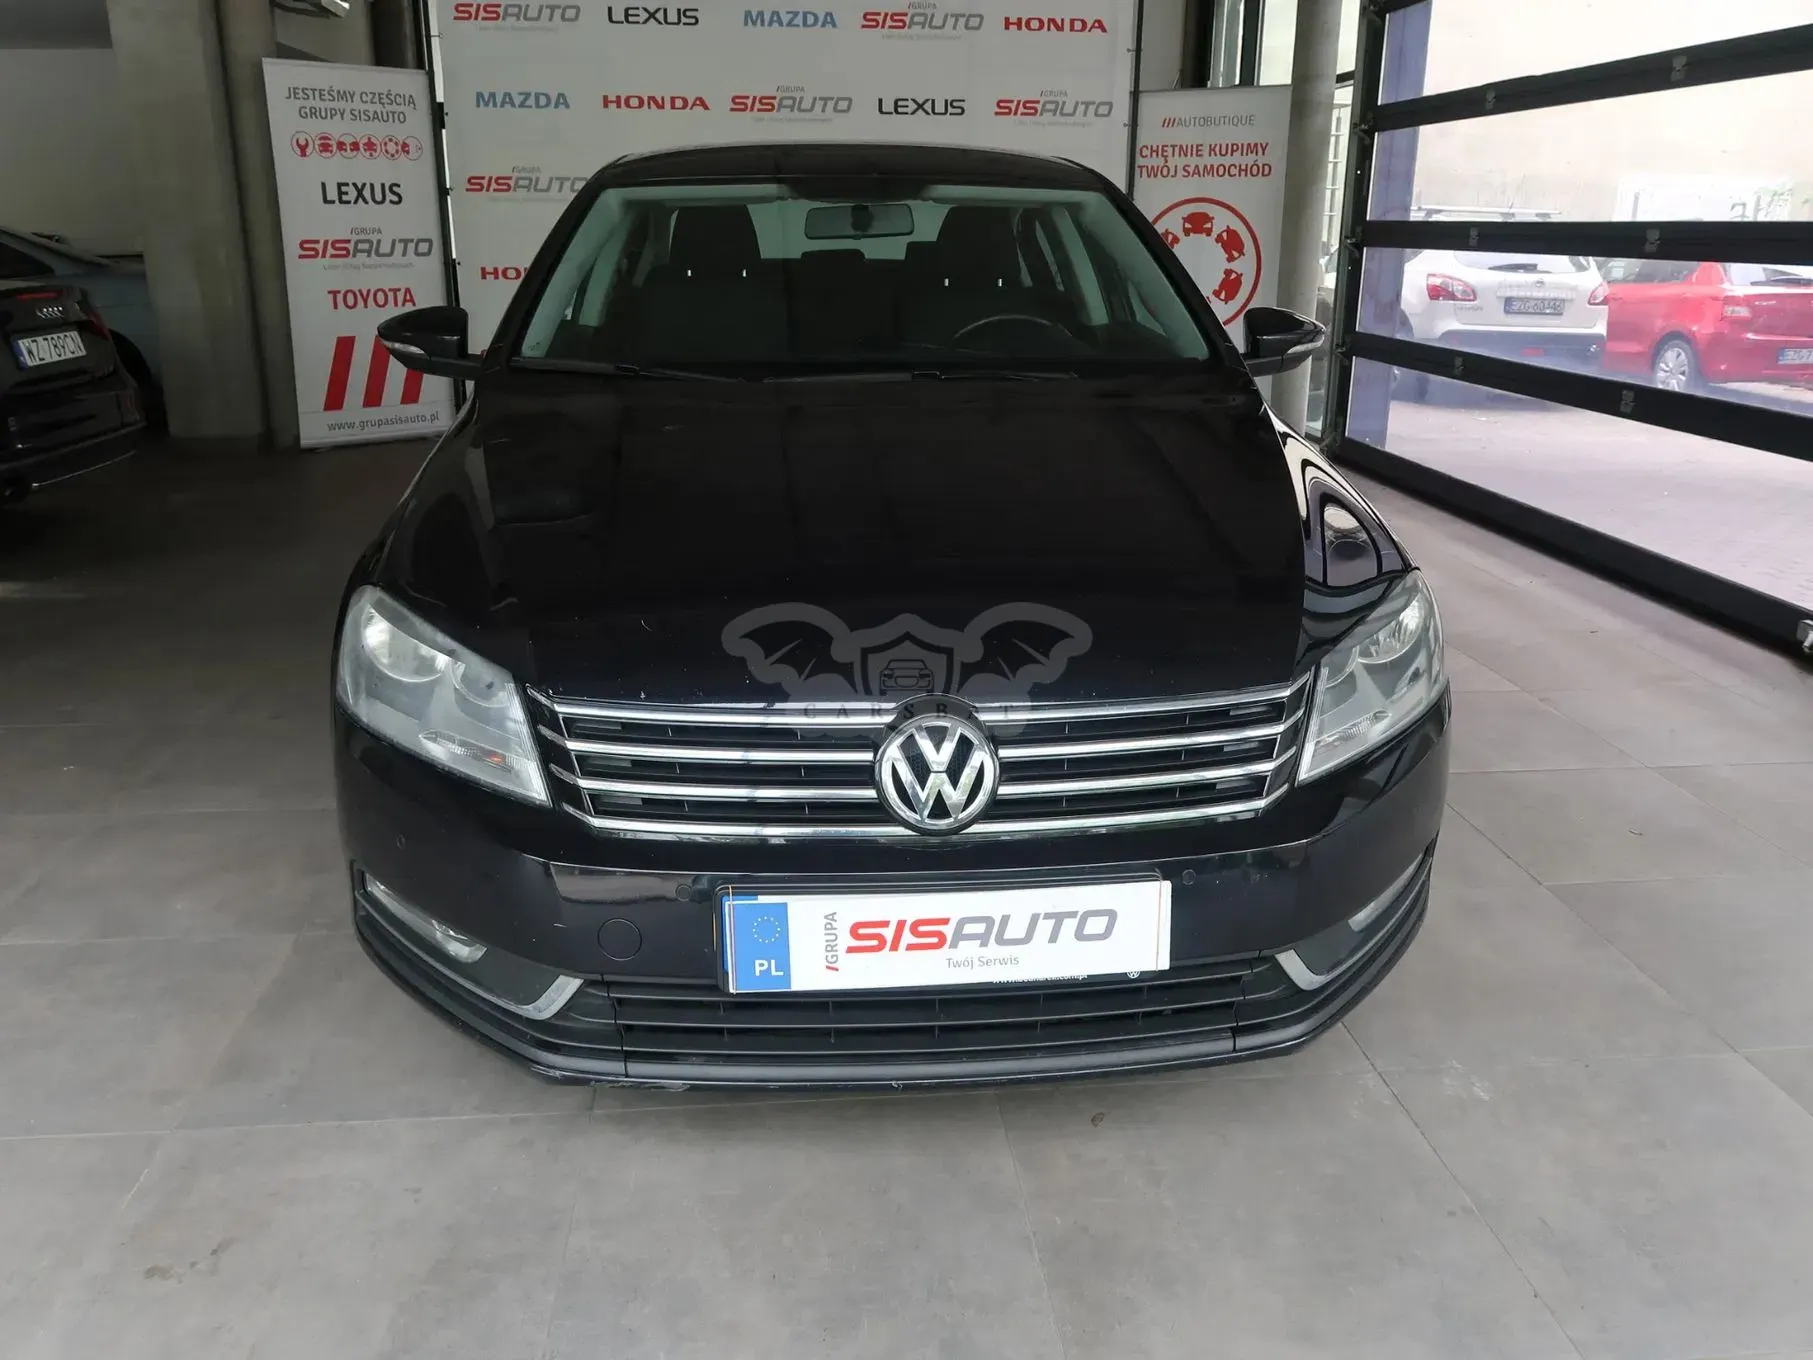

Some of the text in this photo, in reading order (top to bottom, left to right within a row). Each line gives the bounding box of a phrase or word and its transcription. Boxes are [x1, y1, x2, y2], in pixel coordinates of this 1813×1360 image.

[453, 3, 580, 22] SISAUTO
[607, 6, 699, 26] LEXUS
[743, 10, 837, 29] MAZDA
[861, 11, 984, 30] SISAUTO
[1004, 17, 1108, 33] HONDA
[285, 86, 417, 110] JESTEŚMY CZĘŚCIĄ
[475, 91, 570, 109] MAZDA
[602, 94, 710, 111] HONDA
[729, 95, 853, 113] SISAUTO
[878, 98, 965, 116] LEXUS
[299, 106, 406, 124] GRUPY SISAUTO
[994, 99, 1113, 117] SISAUTO
[1139, 142, 1269, 163] CHĘTNIE KUPIMY
[1137, 160, 1272, 178] TWÓJ SAMOCHÓD
[321, 182, 403, 205] LEXUS
[298, 238, 433, 259] SISAUTO
[327, 288, 417, 310] TOYOTA
[327, 410, 440, 431] www.grupasisauto.pl
[845, 909, 1118, 954] SISAUTO
[754, 959, 784, 977] PL
[946, 955, 1020, 971] Twój Serwis
